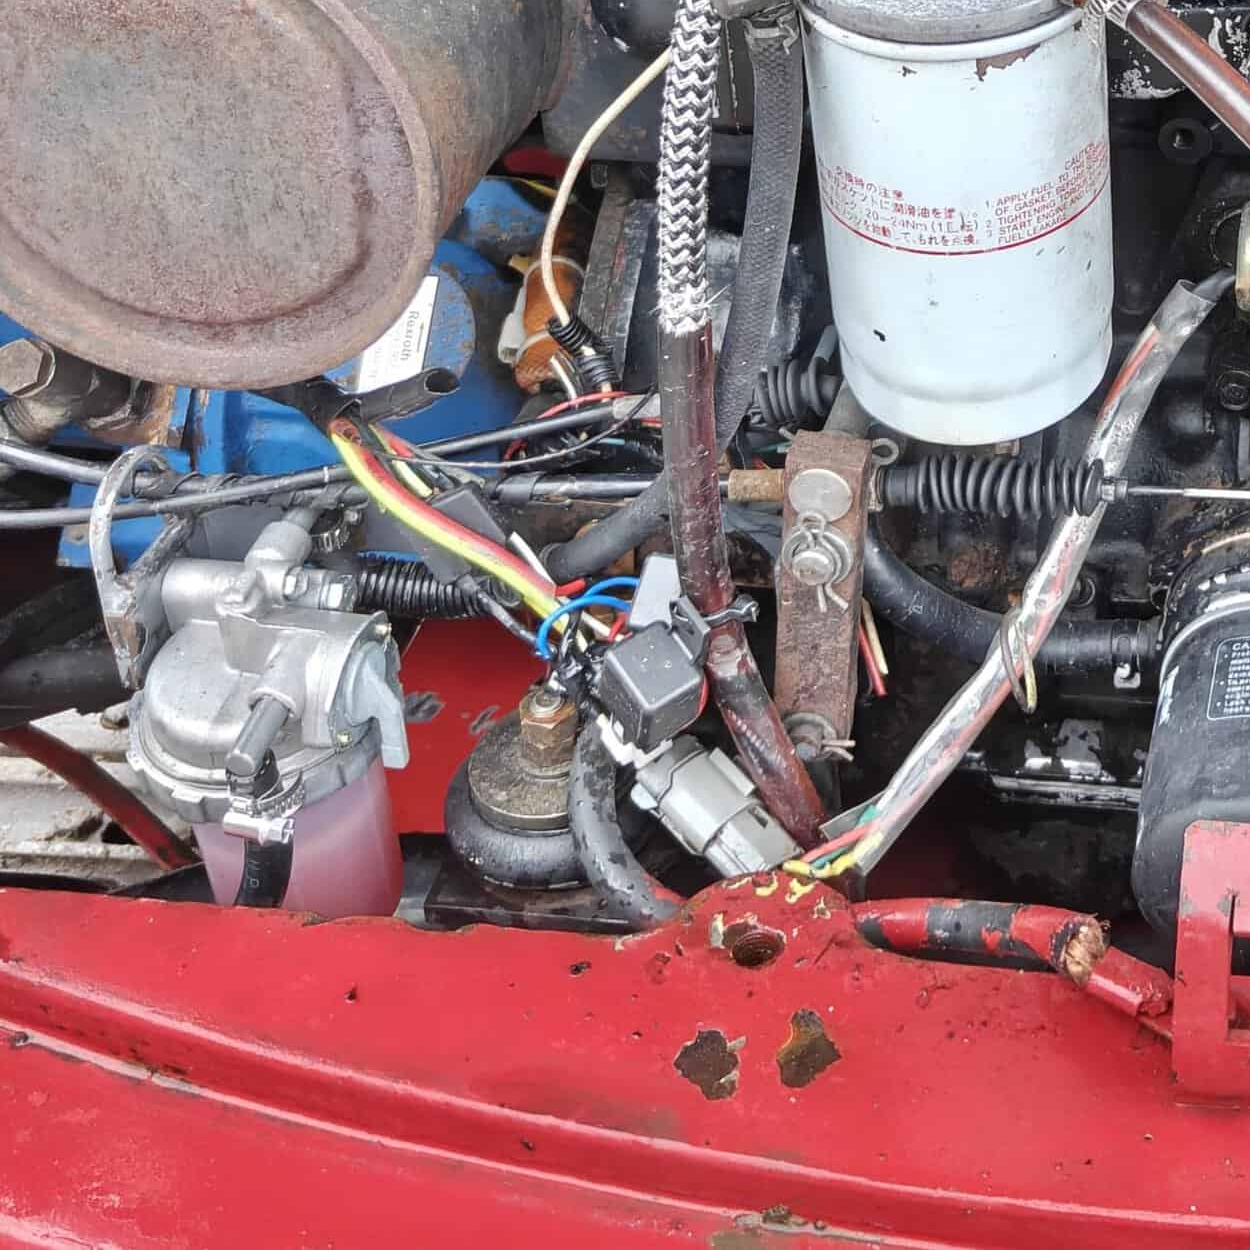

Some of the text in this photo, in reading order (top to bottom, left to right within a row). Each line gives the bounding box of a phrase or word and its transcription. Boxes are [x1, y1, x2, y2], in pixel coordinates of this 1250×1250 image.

[995, 205, 1009, 217] OF
[1015, 191, 1053, 212] GASKET
[997, 190, 1029, 207] APPLY
[1031, 182, 1054, 197] FUEL
[998, 199, 1056, 226] TIGHTENING
[998, 231, 1025, 245] FUEL
[1000, 219, 1032, 236] START
[400, 310, 420, 361] Rexroth
